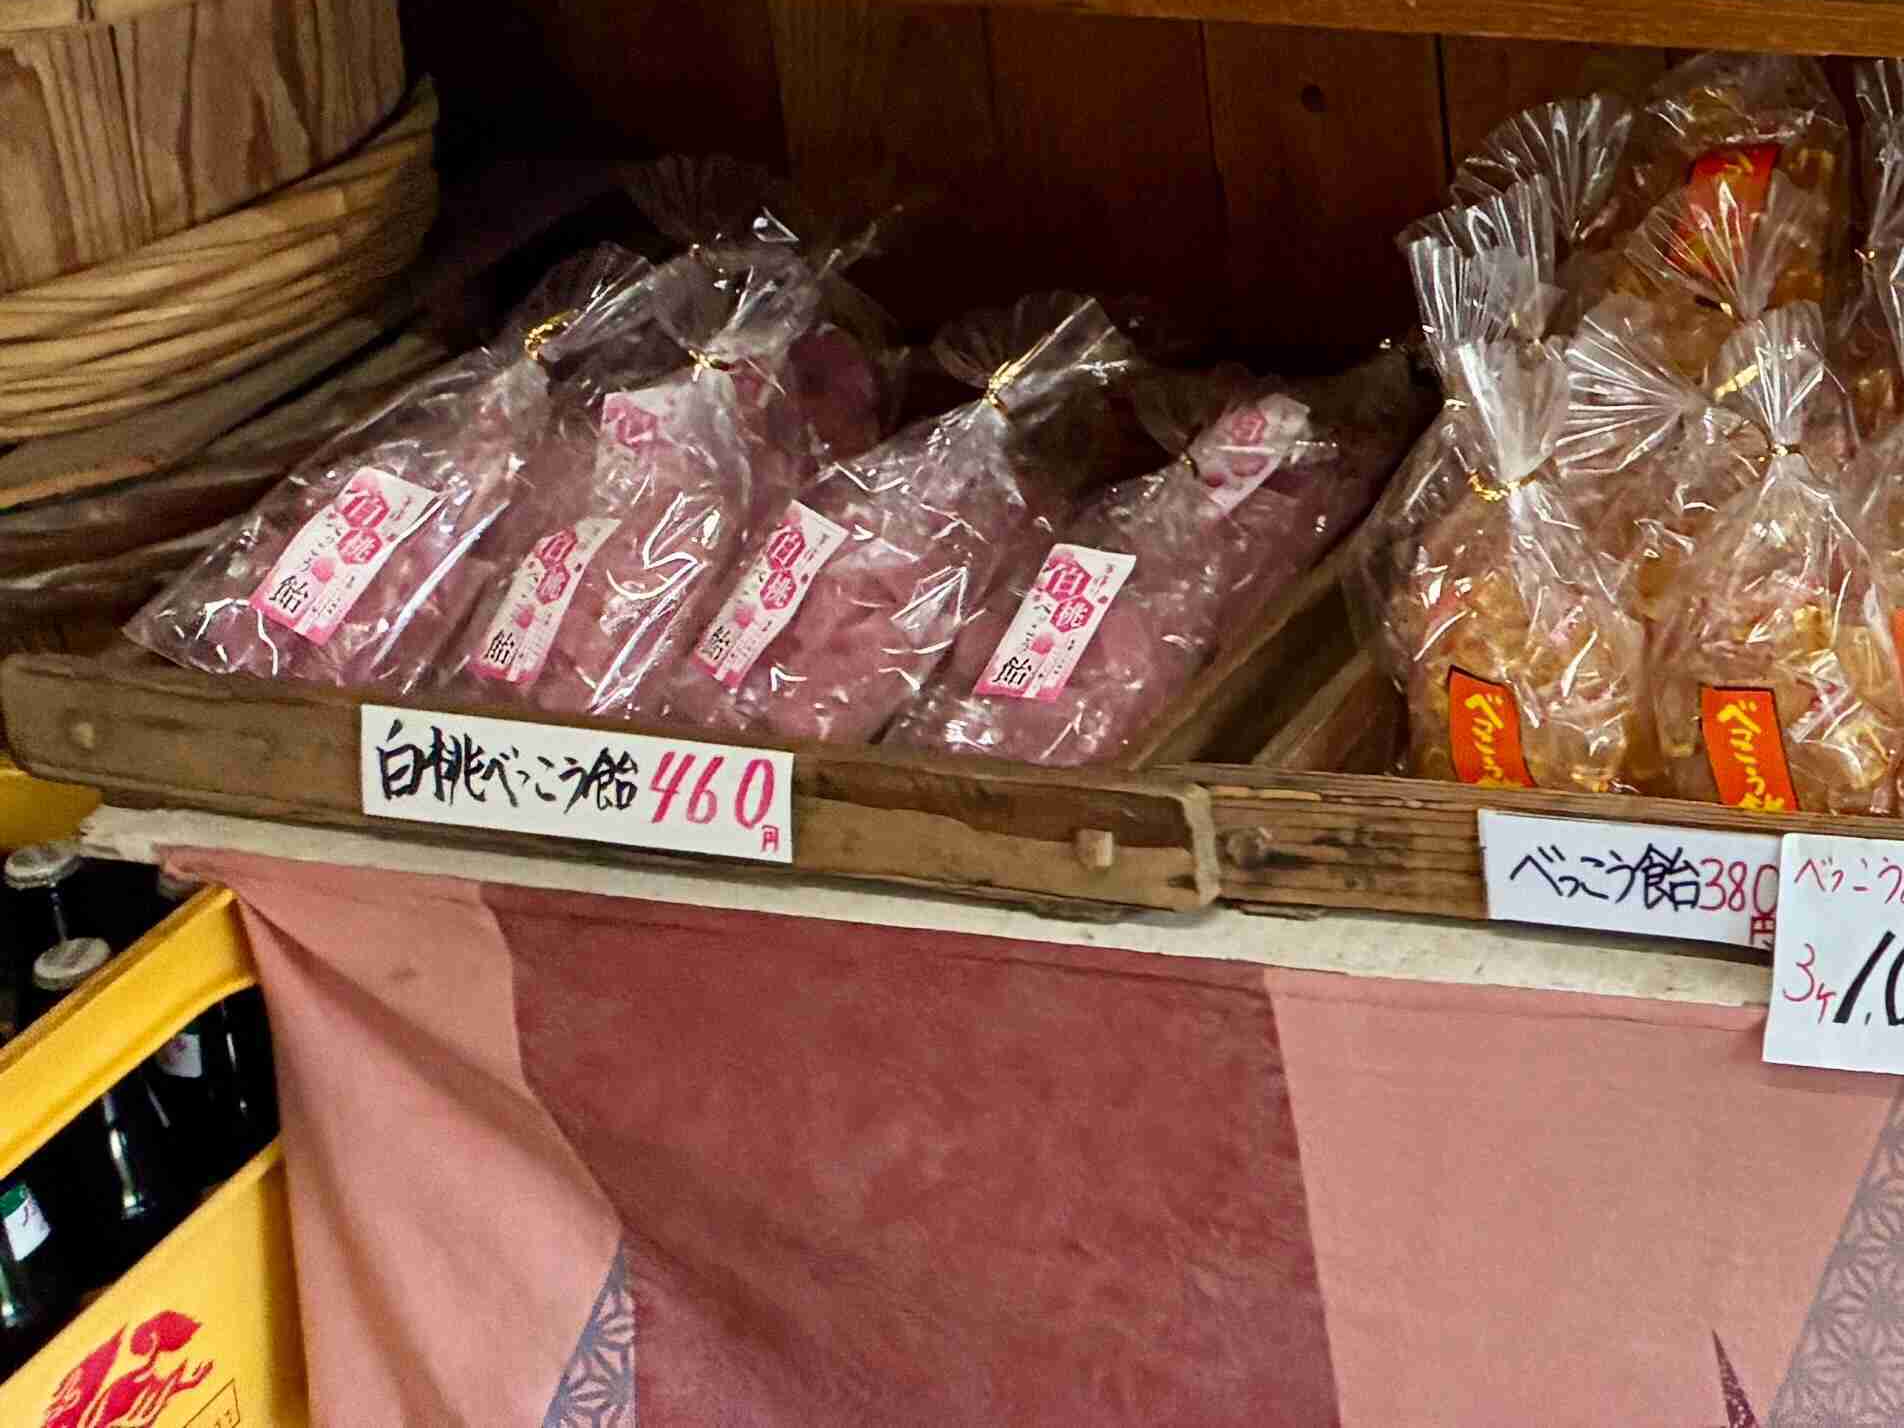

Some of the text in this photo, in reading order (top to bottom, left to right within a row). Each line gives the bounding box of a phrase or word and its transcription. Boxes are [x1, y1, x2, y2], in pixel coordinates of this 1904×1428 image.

[1044, 559, 1096, 633] 白桃
[1464, 692, 1518, 789] べっこう
[375, 719, 782, 853] 白桃べっこう飴 460円
[1509, 842, 1703, 914] べっこう飴
